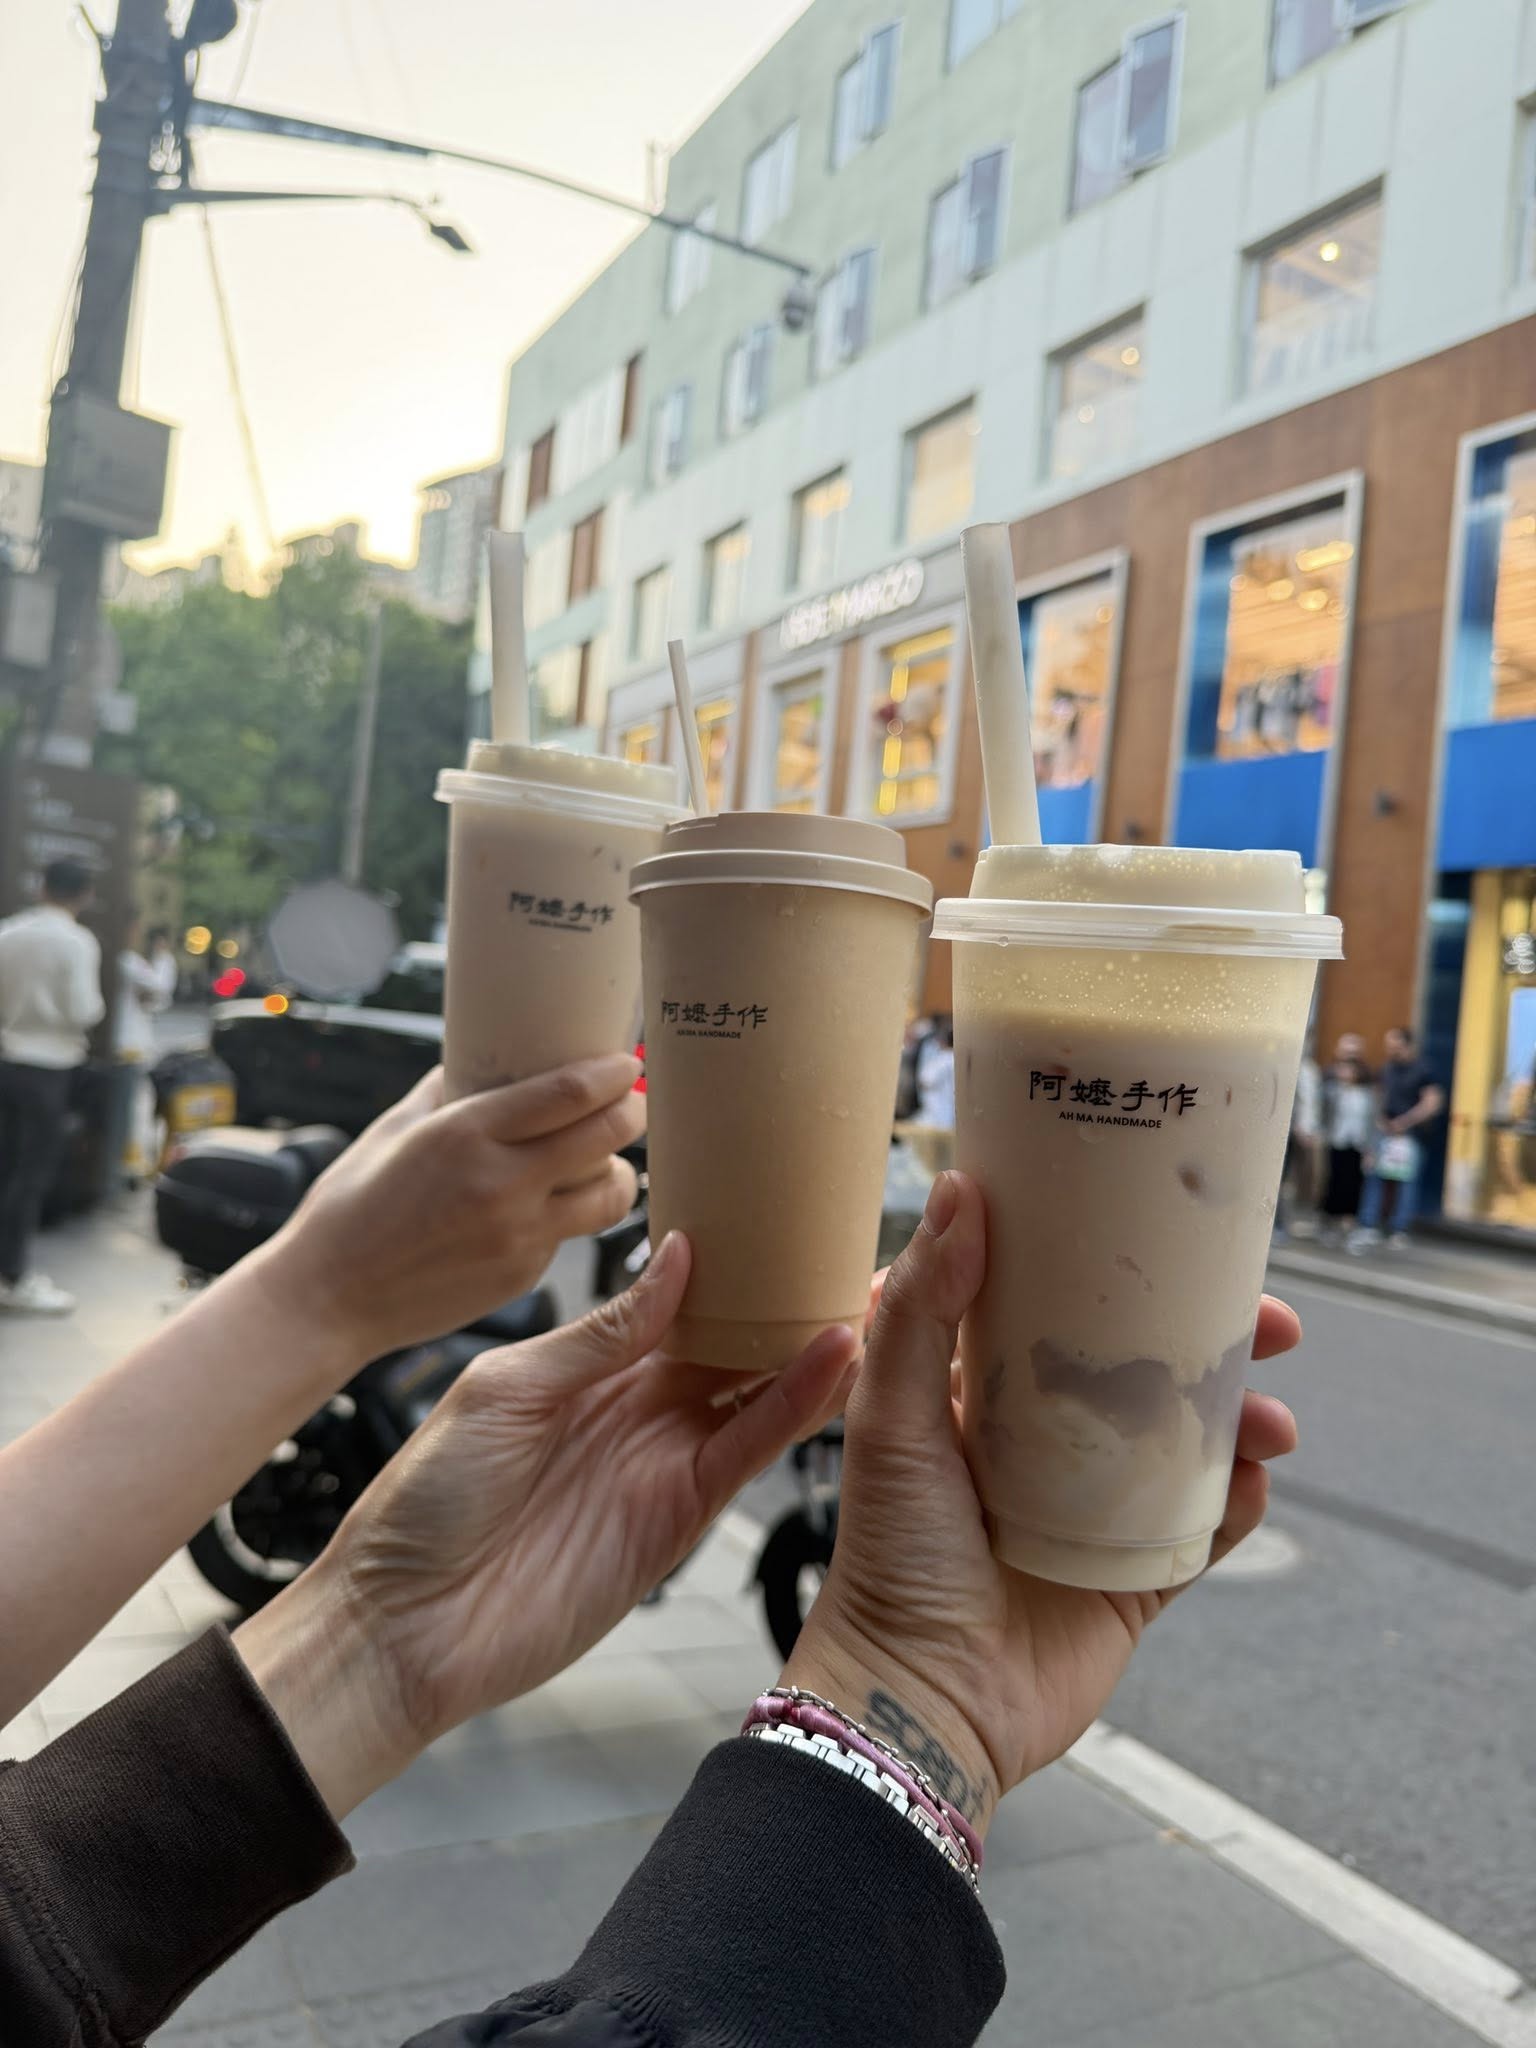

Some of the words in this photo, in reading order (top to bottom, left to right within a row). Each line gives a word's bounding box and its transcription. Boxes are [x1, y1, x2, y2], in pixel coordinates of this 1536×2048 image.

[699, 1030, 742, 1039] HANDMADE
[1029, 1071, 1198, 1116] 阿嬷手作
[1059, 1111, 1074, 1120] AH
[1076, 1113, 1094, 1123] MA
[1096, 1115, 1162, 1129] HANDMADE
